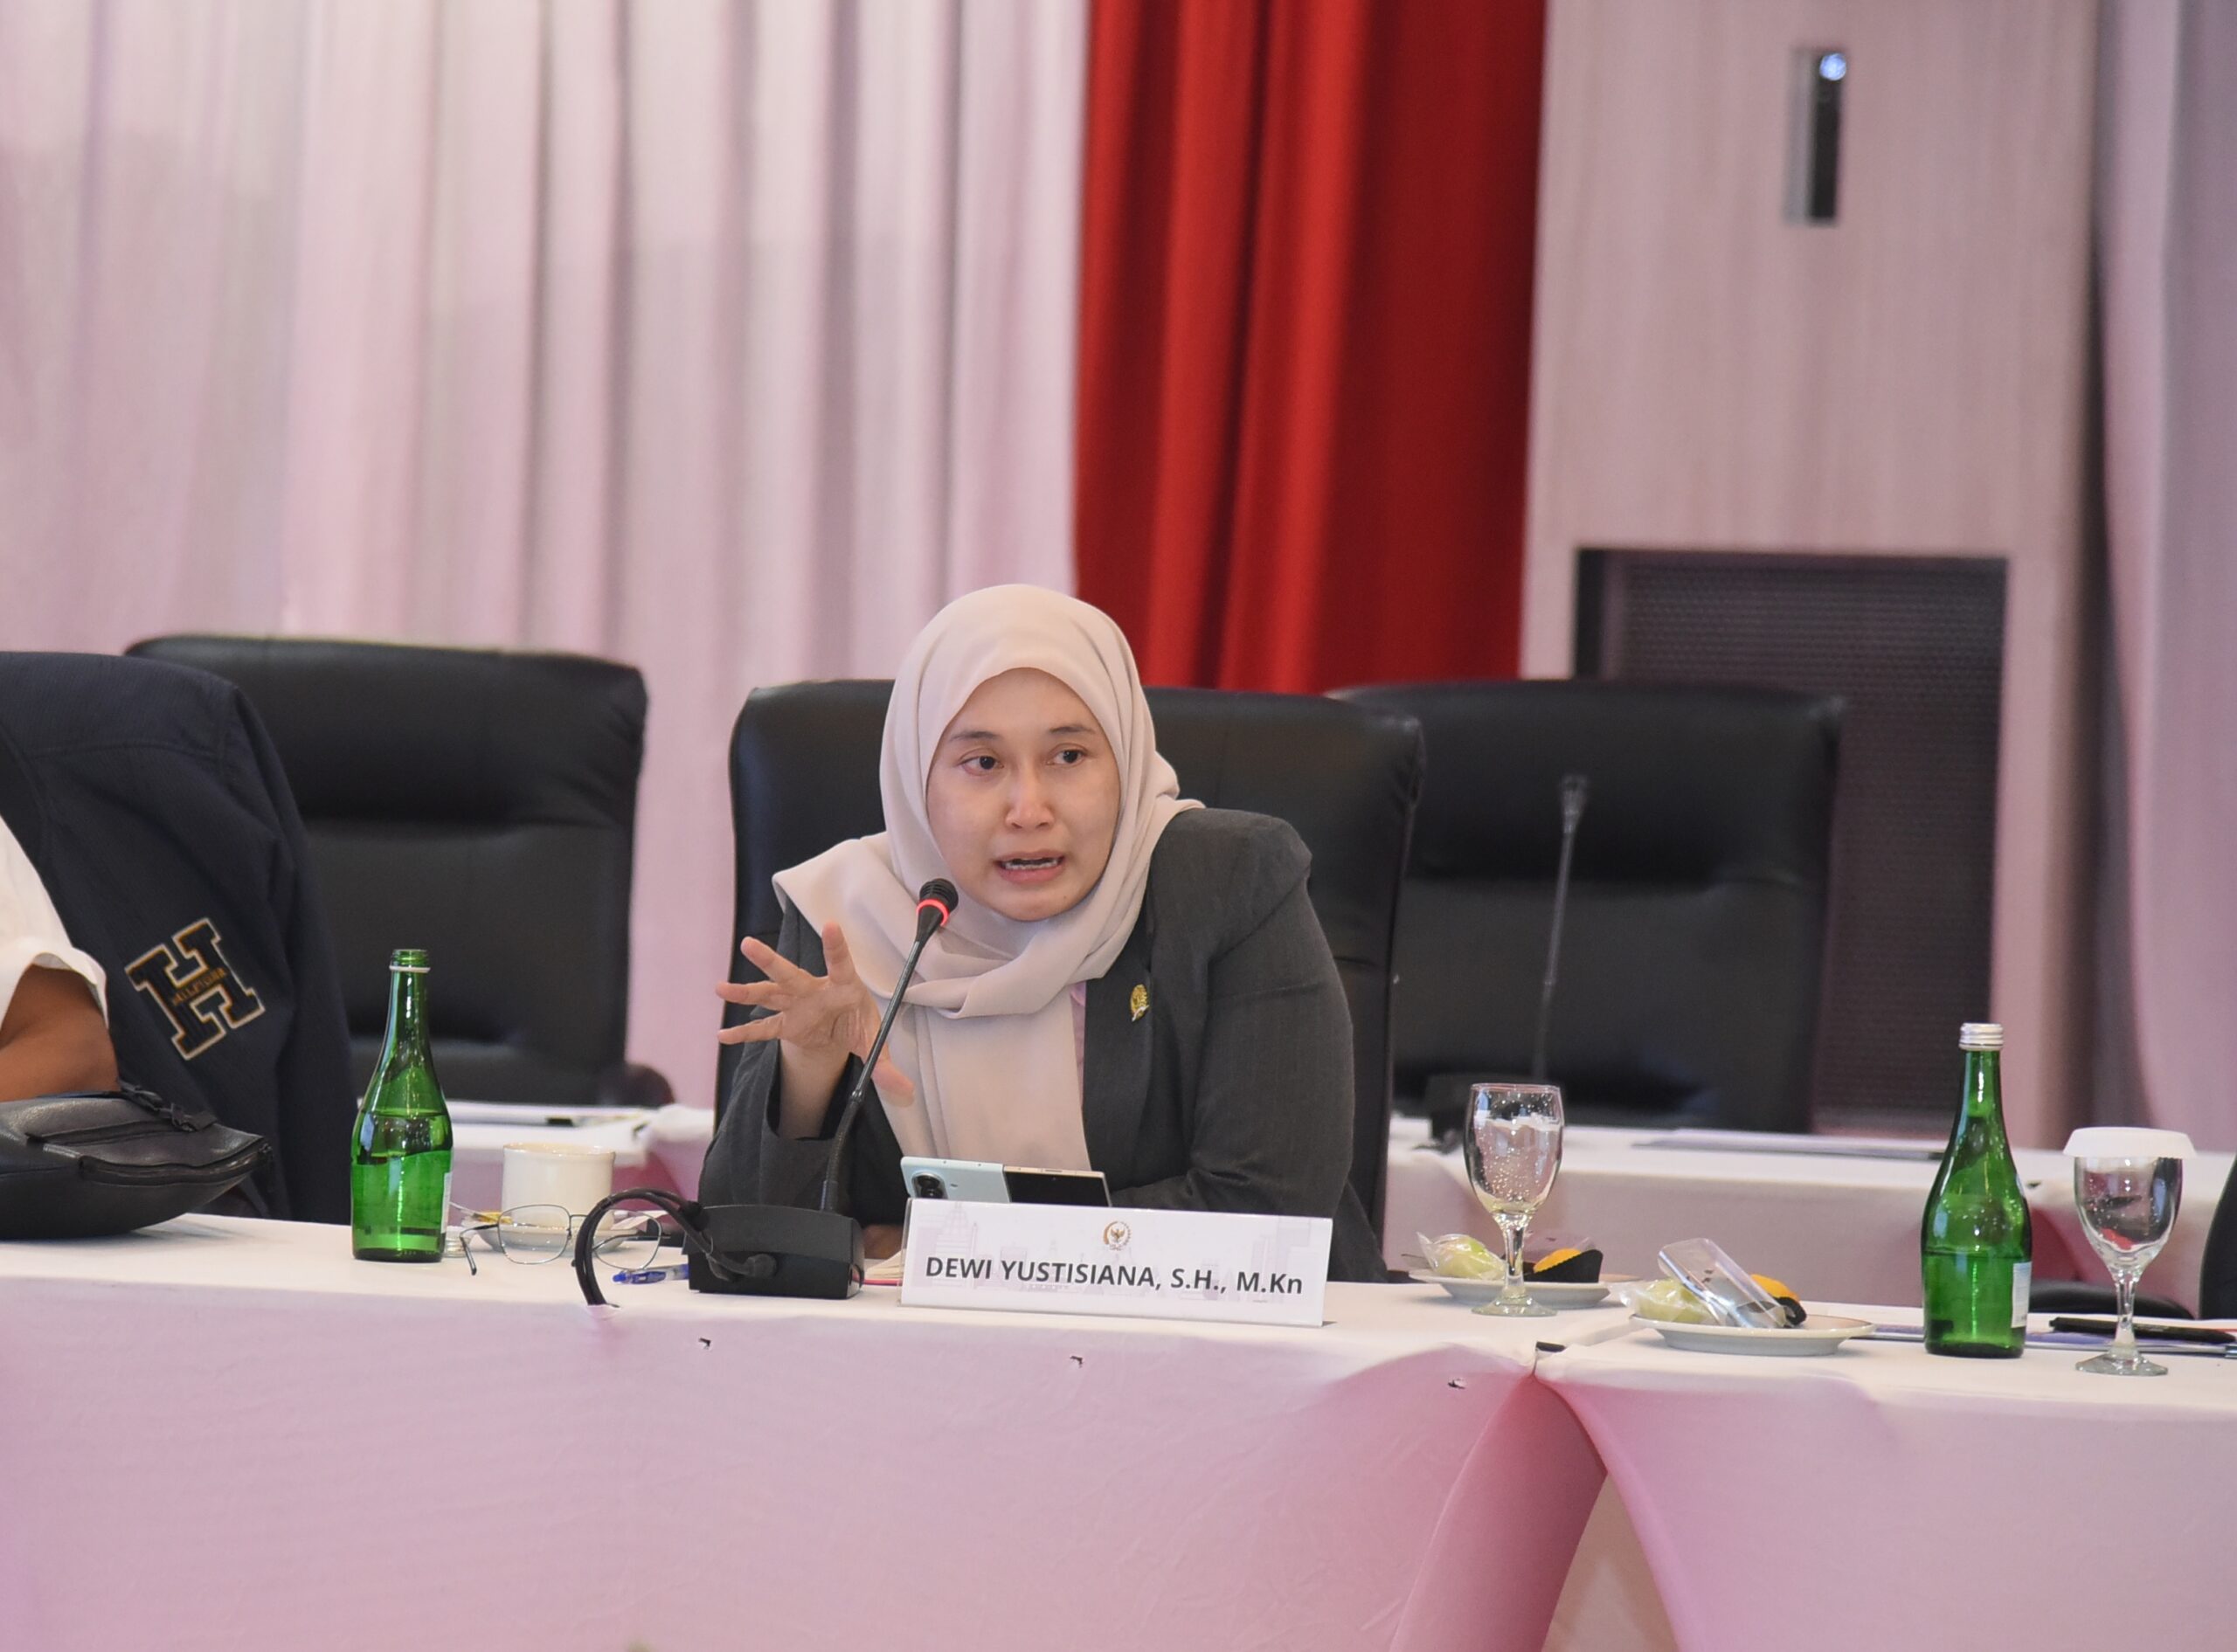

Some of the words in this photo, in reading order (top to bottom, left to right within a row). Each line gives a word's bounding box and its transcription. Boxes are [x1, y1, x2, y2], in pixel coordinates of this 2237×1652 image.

[124, 917, 266, 1061] H
[926, 1256, 992, 1279] DEWI
[1001, 1261, 1161, 1290] YUSTISIANA,
[1171, 1269, 1226, 1294] S.H.,
[1236, 1272, 1302, 1294] M.Kn
